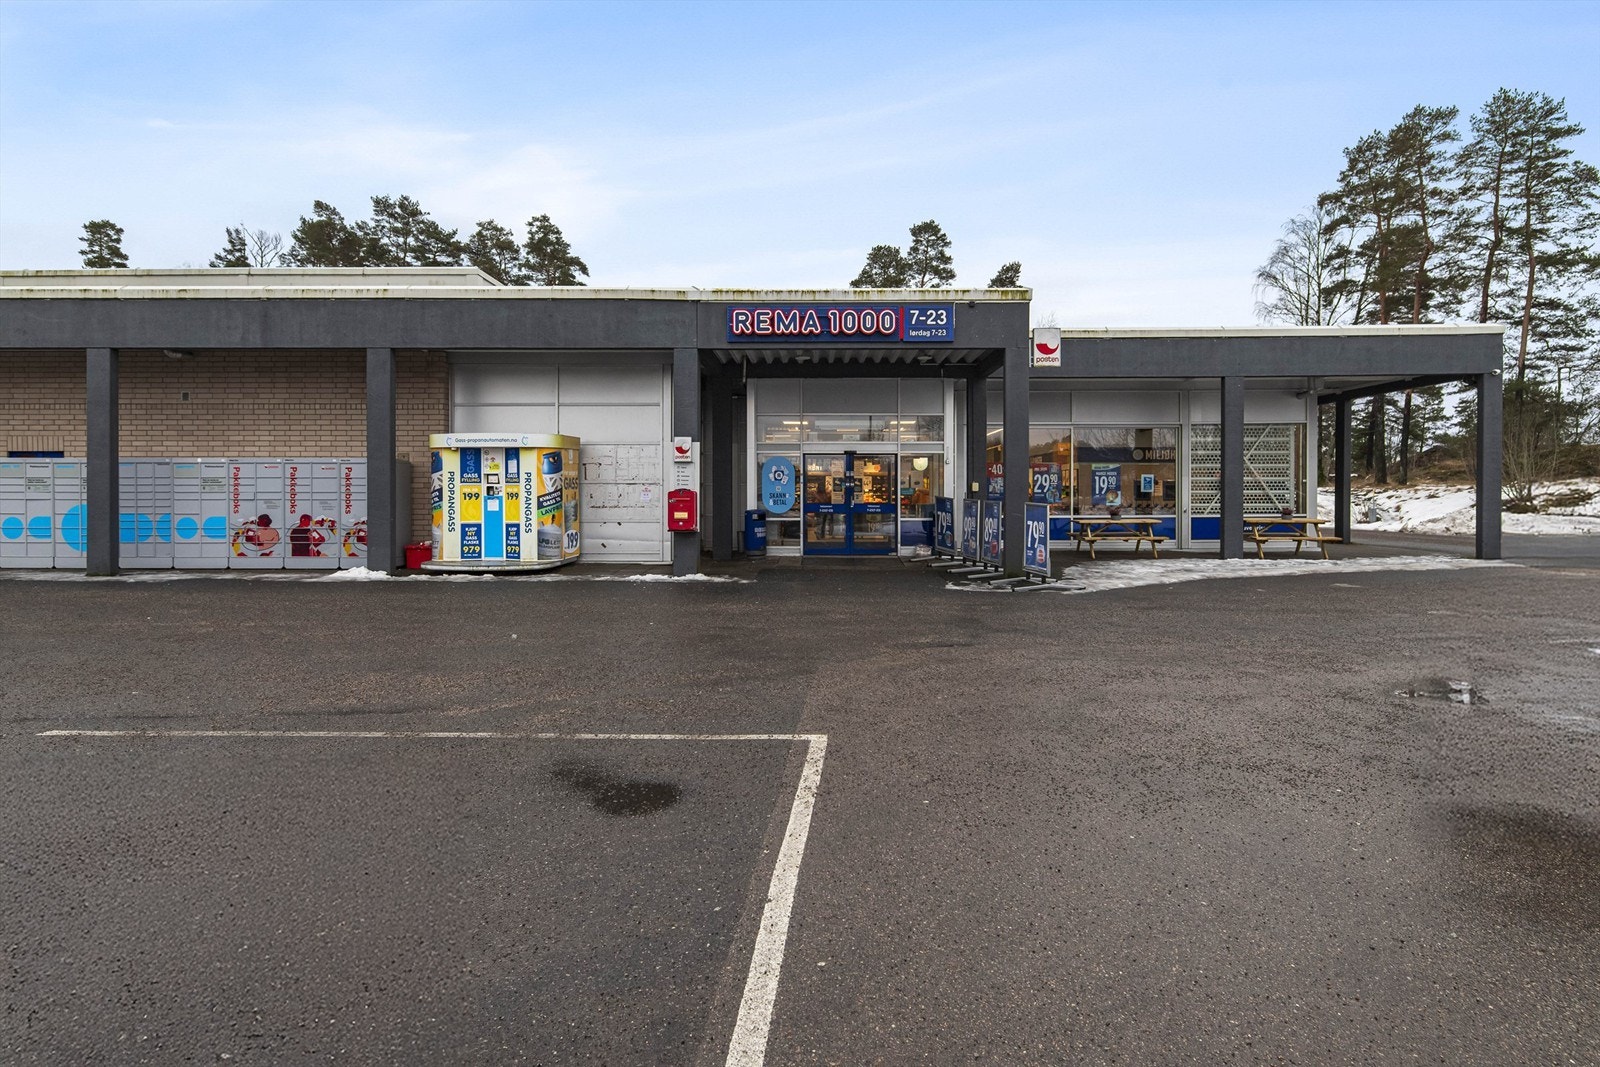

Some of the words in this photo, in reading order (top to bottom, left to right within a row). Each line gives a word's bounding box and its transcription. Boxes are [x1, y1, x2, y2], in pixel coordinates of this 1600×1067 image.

[732, 309, 822, 334] REMA
[828, 309, 896, 334] 1000
[909, 310, 947, 325] 7-23
[909, 329, 929, 337] lørdag
[564, 477, 579, 490] GASS
[447, 471, 455, 533] PROPANGASS
[463, 492, 480, 500] 199
[507, 492, 519, 500] 199
[524, 472, 532, 534] PROPANGASS
[567, 532, 578, 549] 199
[463, 545, 480, 553] 979
[507, 545, 519, 553] 979
